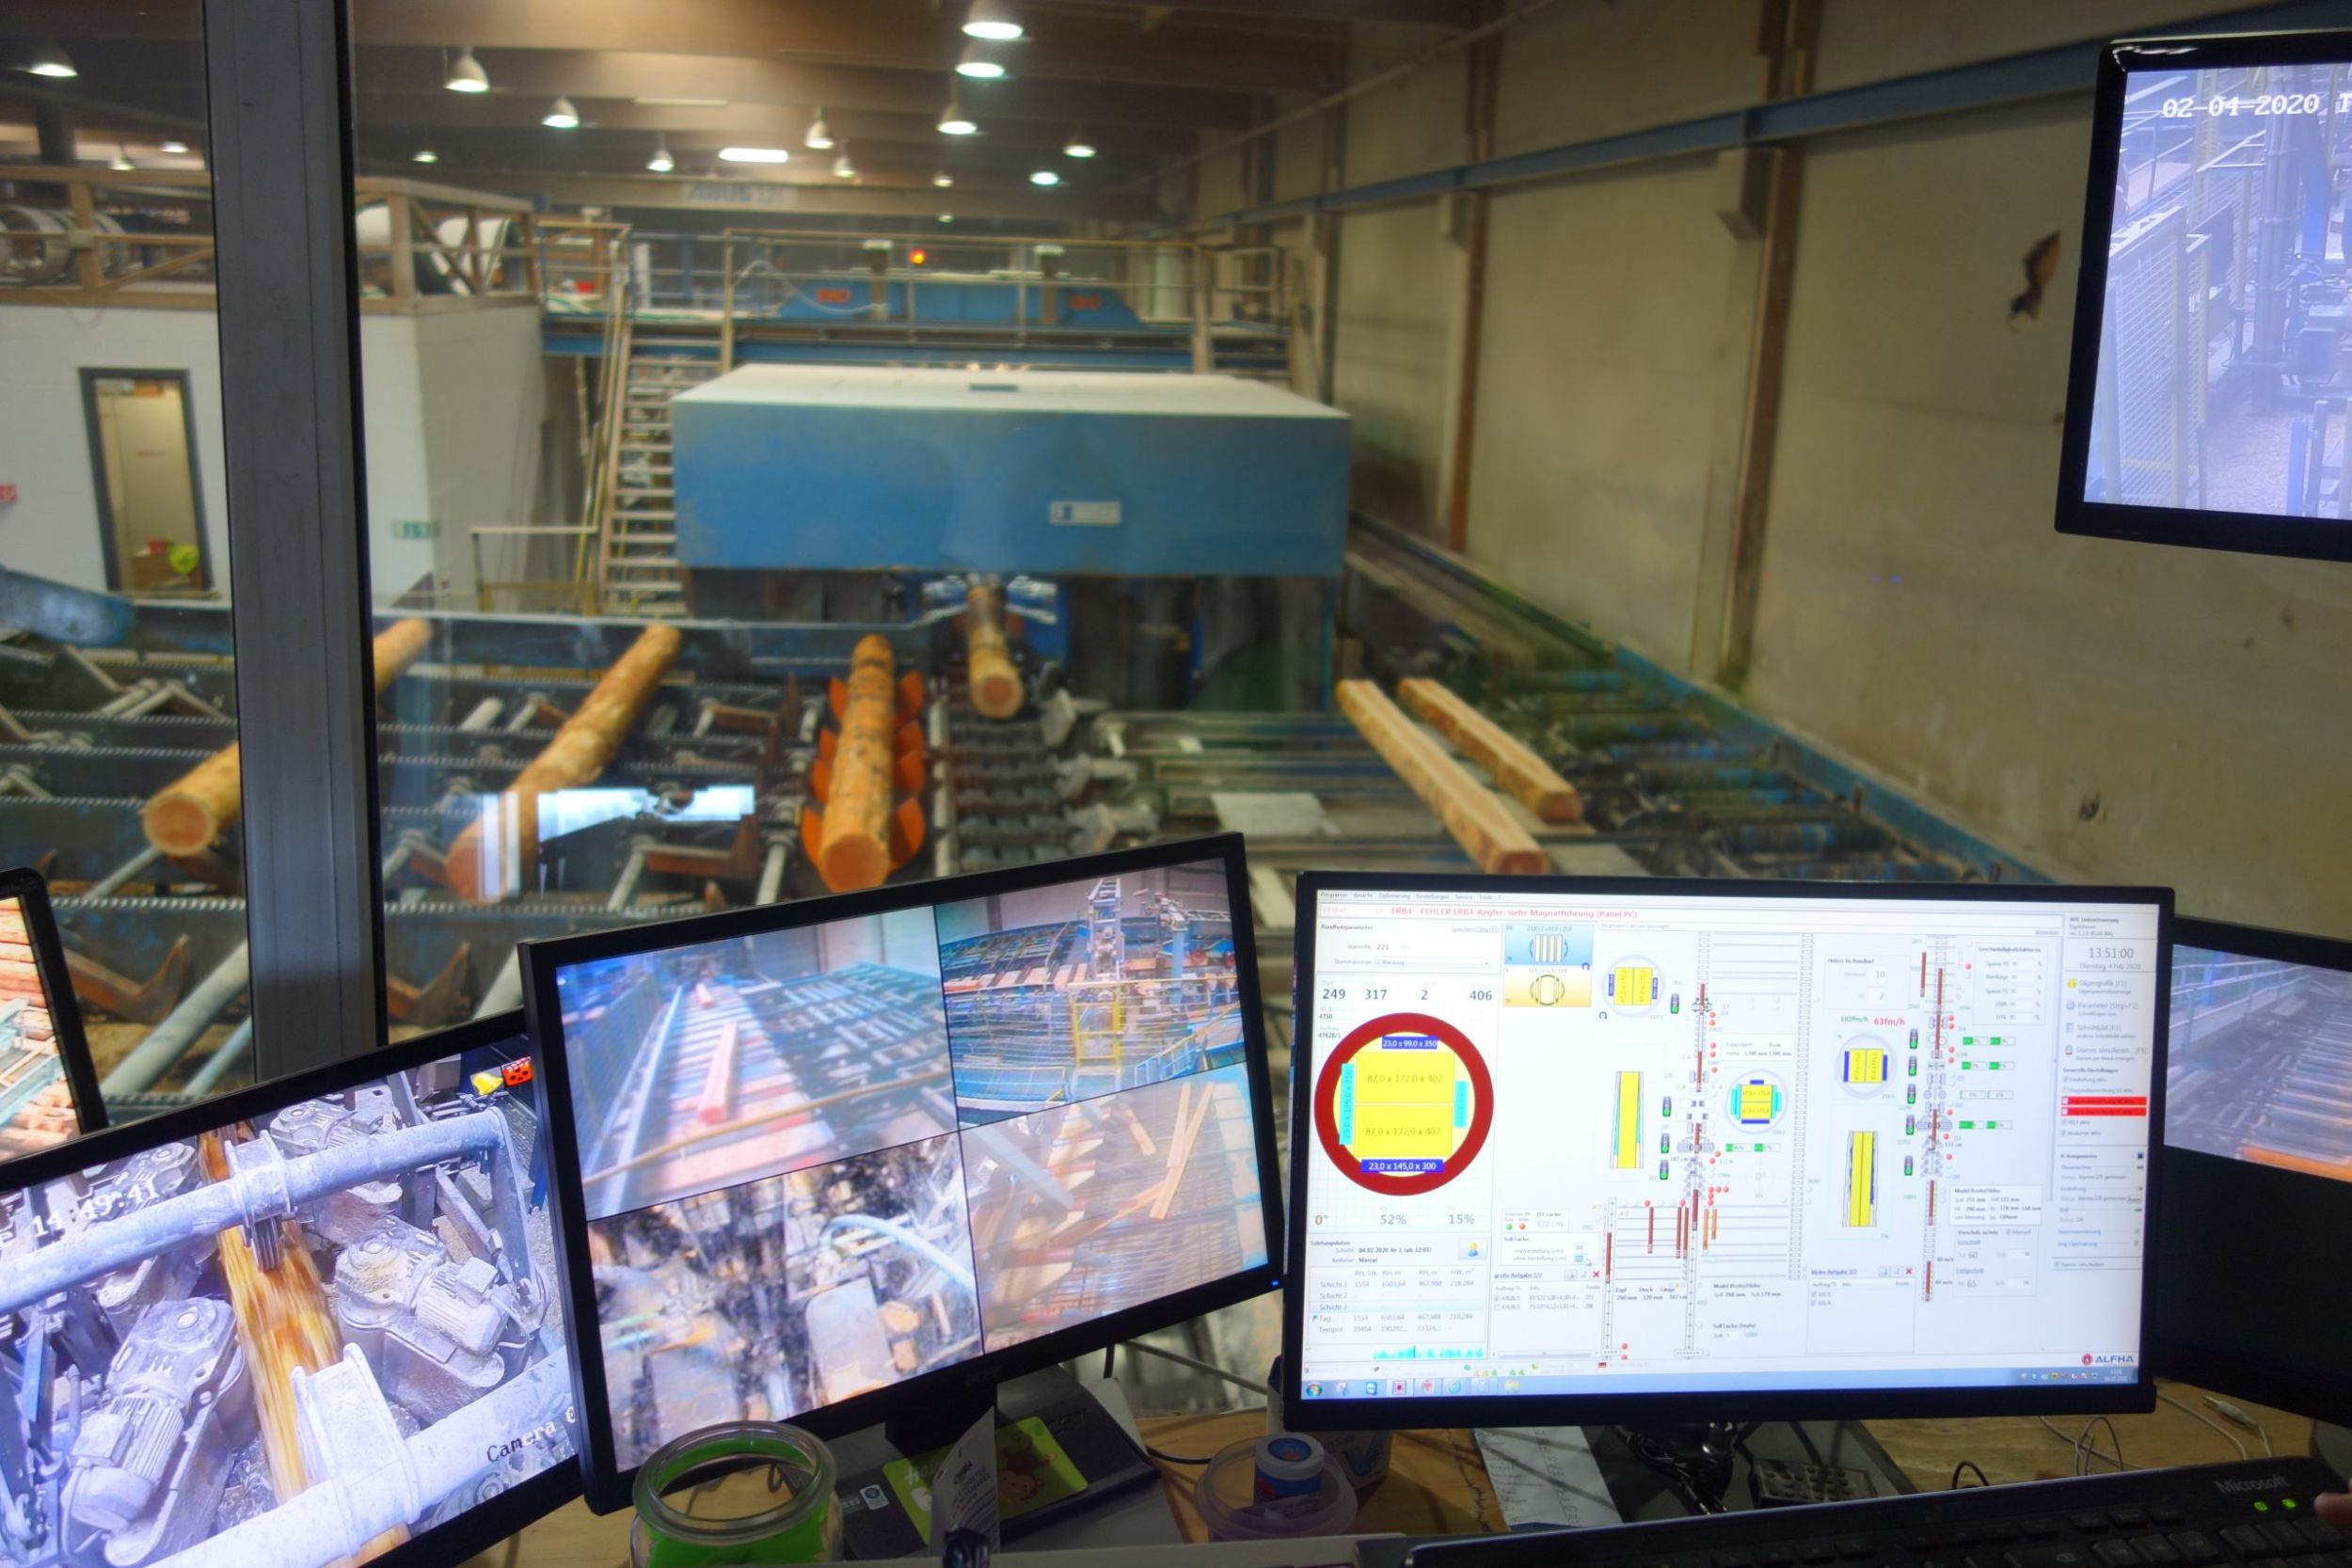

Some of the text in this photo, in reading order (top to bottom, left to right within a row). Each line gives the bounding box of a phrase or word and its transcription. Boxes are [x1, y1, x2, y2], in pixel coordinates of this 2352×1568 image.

[2162, 93, 2320, 118] 02-04-2020
[1420, 907, 1451, 916] FEHLER
[1507, 909, 1528, 917] siehe
[1530, 910, 1595, 919] Magnetführung
[1596, 910, 1622, 920] (Panel
[1623, 910, 1638, 920] PC)
[2089, 947, 2135, 959] 13:51:00
[1322, 988, 1493, 1001] 249 317 2 406
[1873, 1016, 1906, 1026] 63fm/h
[1367, 1074, 1386, 1084] 87,0
[1394, 1074, 1418, 1085] 172,0
[1426, 1074, 1443, 1084] 402
[1364, 1127, 1384, 1137] 87,0
[1392, 1127, 1416, 1137] 172,0
[1424, 1127, 1441, 1136] 402
[1368, 1163, 1386, 1171] 23,0
[1392, 1163, 1414, 1171] 145,0
[1379, 1213, 1406, 1226] 52%
[1448, 1213, 1475, 1226] 15%
[1320, 1280, 1342, 1289] Schicht
[1319, 1314, 1331, 1323] Tag
[2095, 1354, 2135, 1363] ALFHA
[485, 1420, 558, 1464] Camera
[2213, 1472, 2291, 1495] Microsoft
